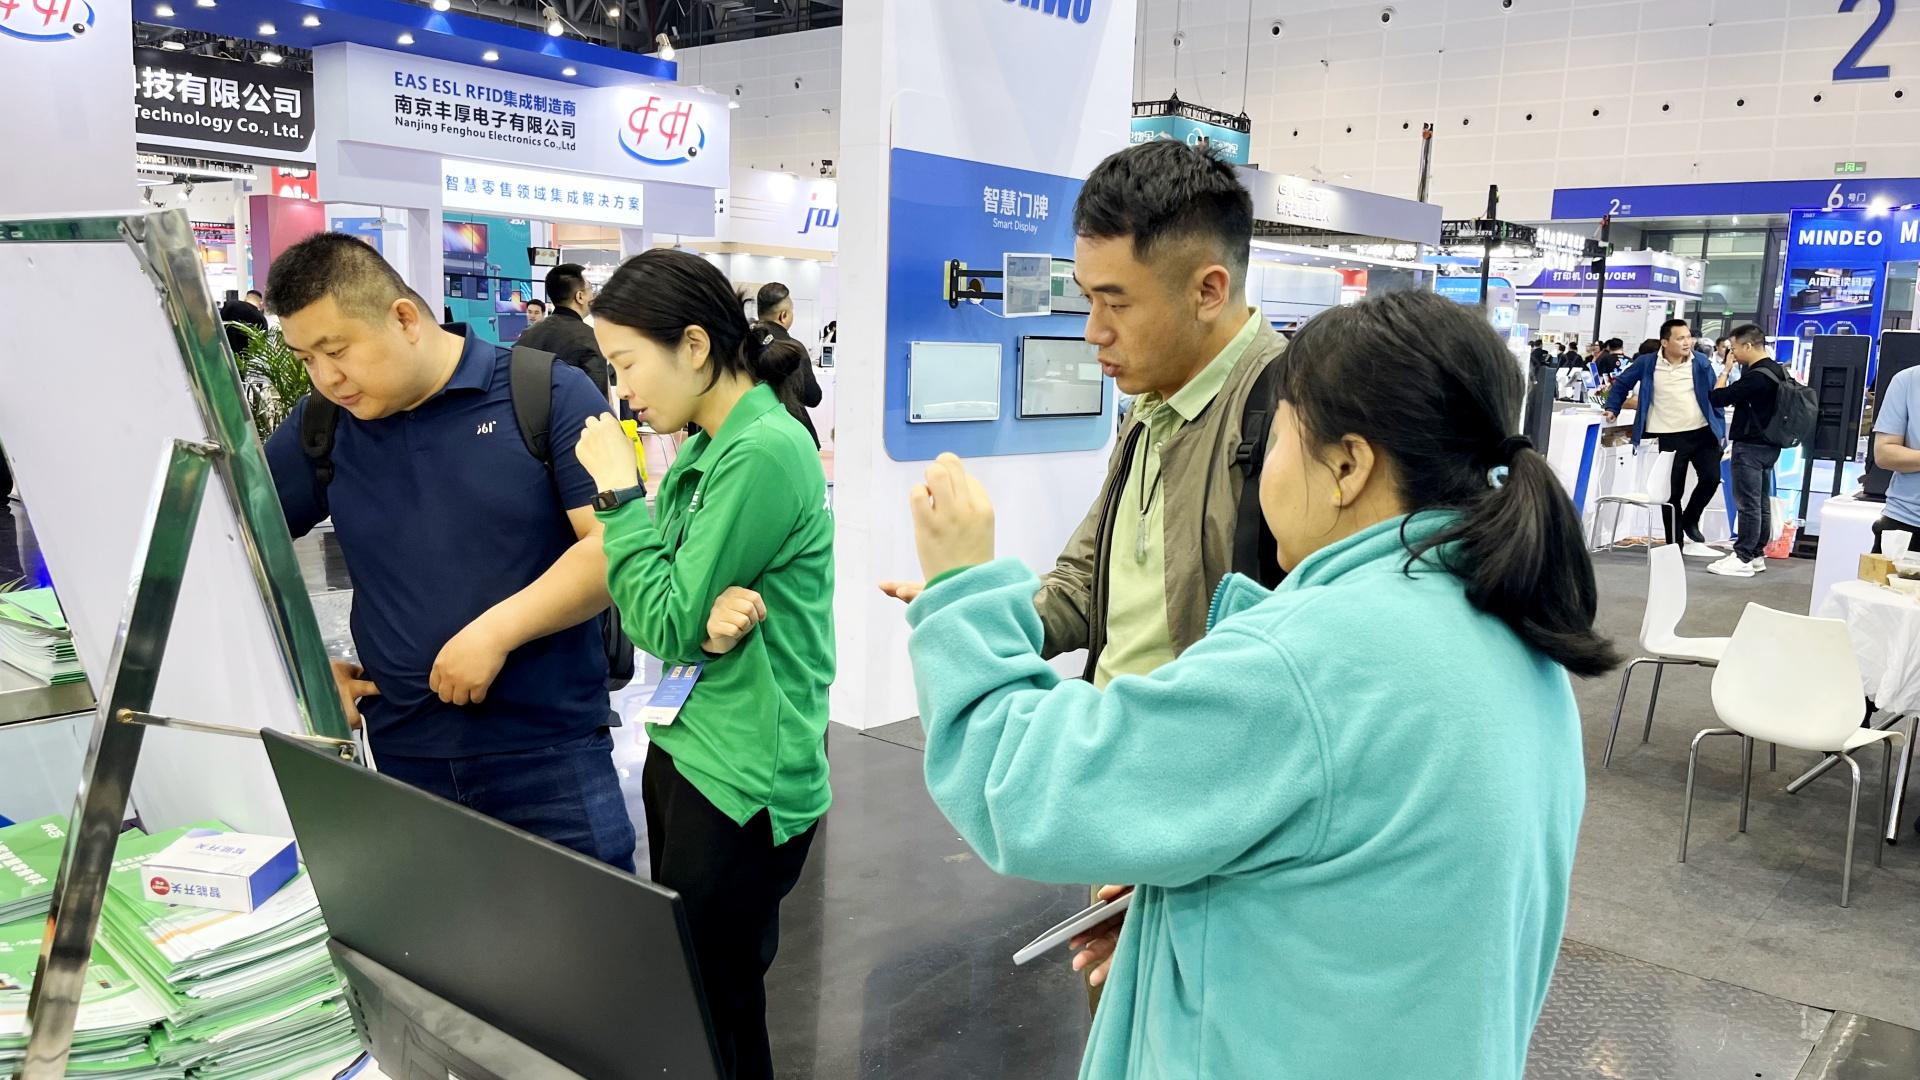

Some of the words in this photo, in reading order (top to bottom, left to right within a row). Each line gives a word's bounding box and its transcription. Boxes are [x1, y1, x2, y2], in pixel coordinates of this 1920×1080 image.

[1832, 0, 1895, 81] 2
[394, 71, 427, 91] EAS
[432, 78, 461, 97] ESL
[466, 84, 576, 117] RFID集成制造商
[135, 105, 233, 133] Technology
[237, 118, 269, 137] Co.,
[273, 122, 304, 139] Ltd.
[394, 94, 576, 139] 南京丰厚电子有限公司
[395, 117, 438, 133] Nanjing
[441, 123, 486, 138] Fenghou
[488, 130, 542, 147] Electronics
[445, 174, 640, 211] 智慧零售领域集成解决方案
[983, 186, 1049, 220] 智慧门牌
[1827, 183, 1844, 209] 6
[1609, 199, 1620, 215] 2
[992, 217, 1013, 230] Smart
[1014, 220, 1038, 235] Display
[1798, 229, 1883, 246] MINDEO
[1900, 219, 1920, 244] M
[1552, 271, 1581, 281] 打印机
[170, 881, 222, 899] 智能开关
